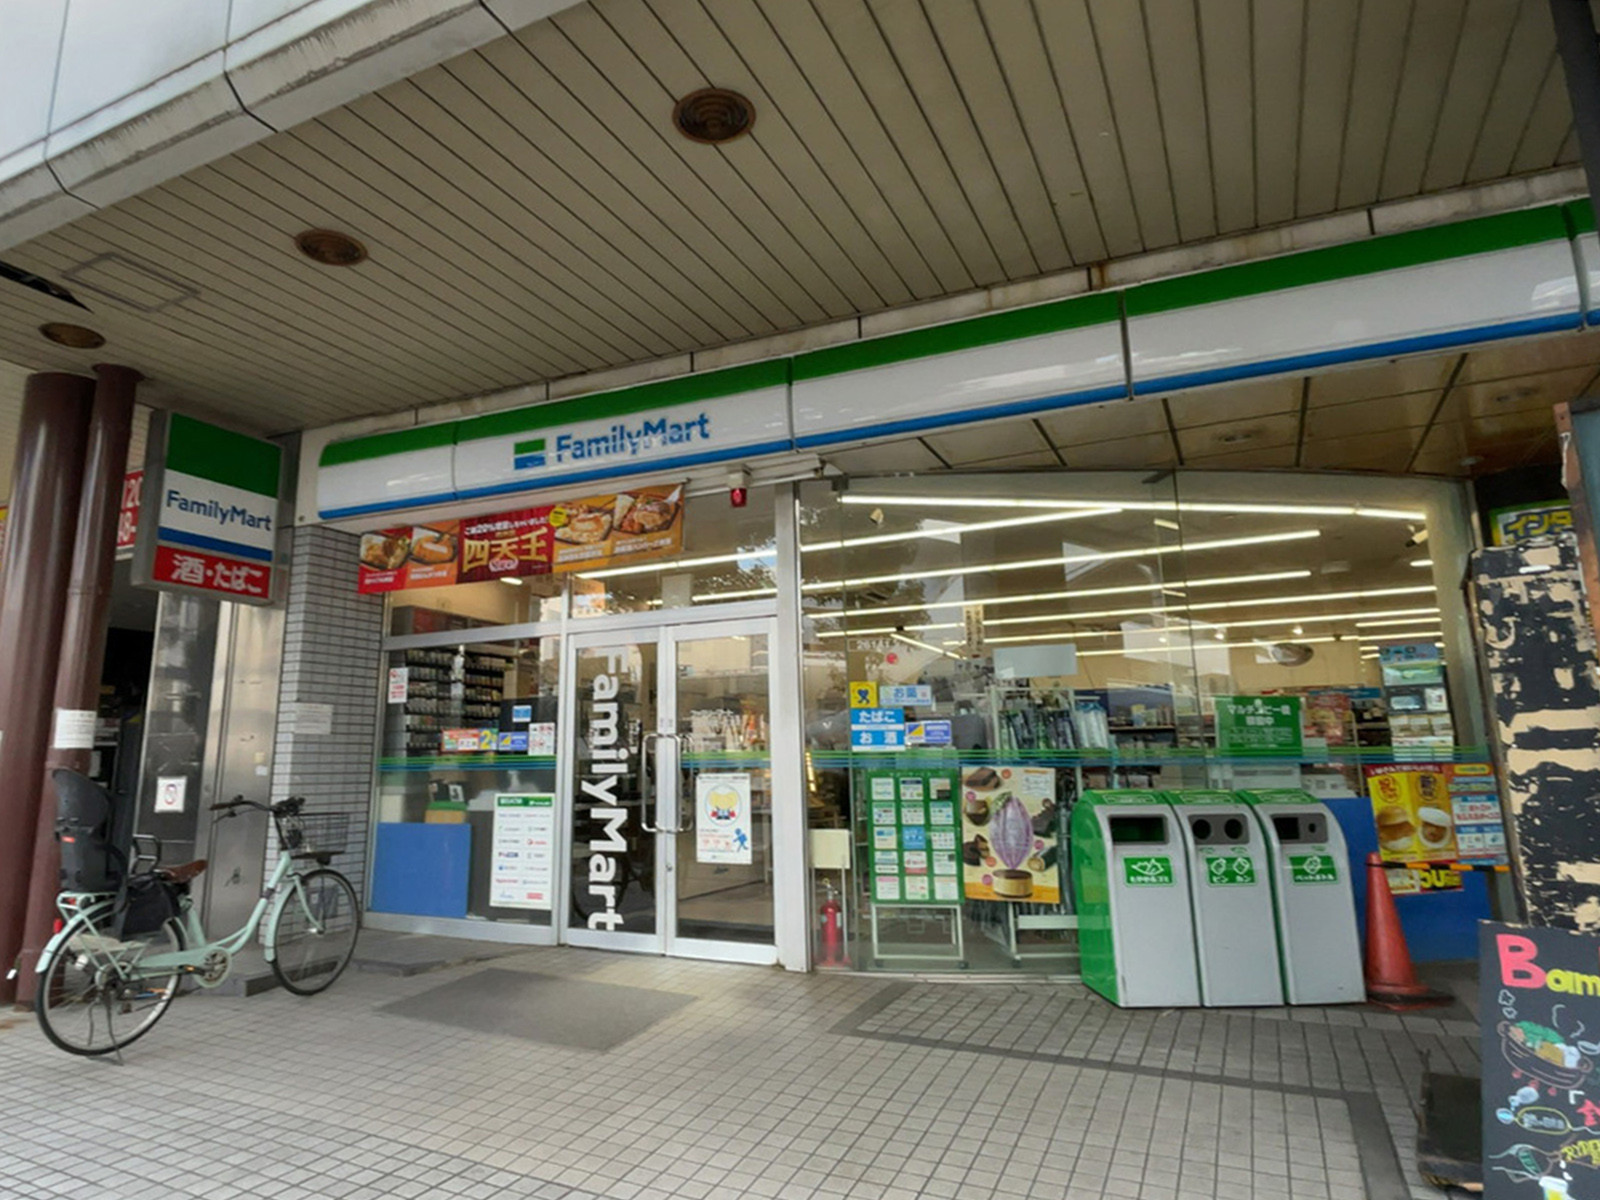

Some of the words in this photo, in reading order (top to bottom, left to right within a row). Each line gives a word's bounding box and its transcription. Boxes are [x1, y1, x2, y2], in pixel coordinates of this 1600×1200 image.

[556, 413, 710, 462] FamilyMart
[166, 490, 272, 532] FamilyMart
[463, 526, 548, 573] 四天王
[171, 553, 263, 595] 酒・たばこ
[858, 710, 896, 723] たばこ
[581, 646, 628, 932] FamilyMart
